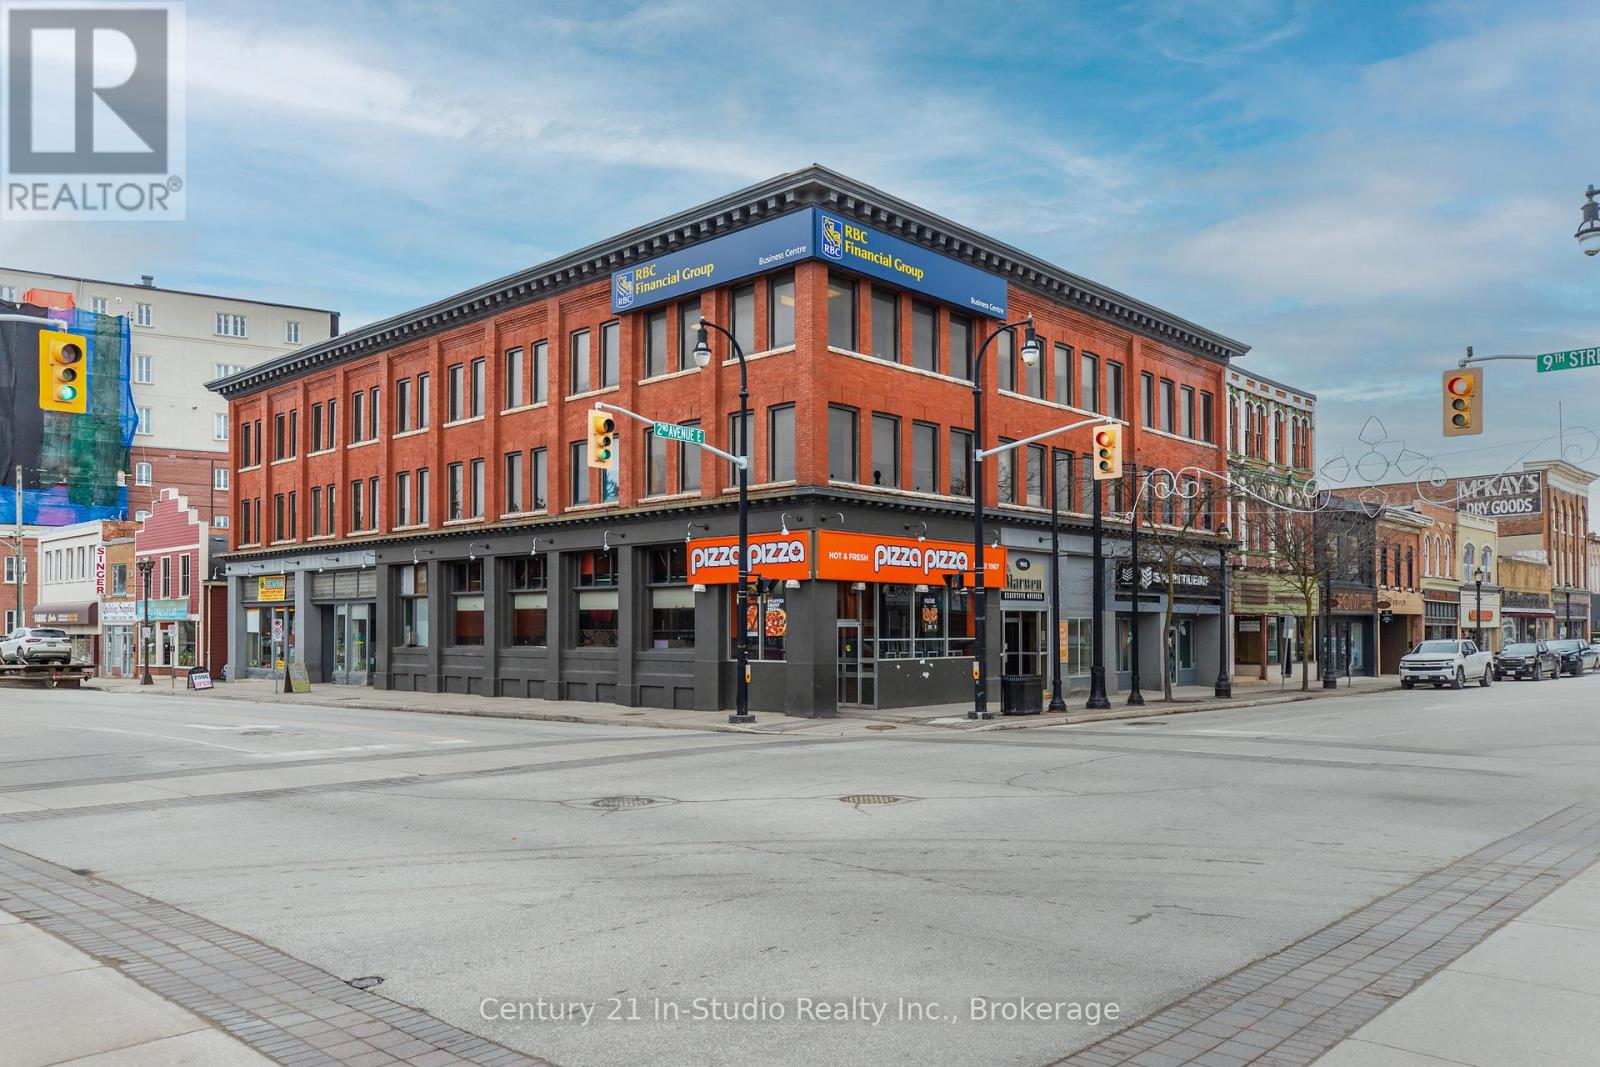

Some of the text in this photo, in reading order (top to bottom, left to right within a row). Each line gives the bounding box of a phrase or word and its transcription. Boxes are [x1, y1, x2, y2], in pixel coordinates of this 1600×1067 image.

[844, 223, 868, 245] RBC
[758, 244, 807, 266] Business Centre
[823, 243, 841, 258] RBC
[844, 240, 924, 283] Financial Group
[635, 264, 657, 281] RBC
[635, 262, 714, 295] Financial Group
[617, 294, 632, 307] RBC
[970, 296, 989, 311] Business
[1542, 352, 1566, 371] 9TH
[668, 425, 695, 441] AVENUE
[696, 430, 702, 443] E
[1465, 497, 1534, 516] DRY GOODS
[747, 540, 805, 573] pizza
[828, 551, 870, 562] HOT & FRESH
[873, 544, 969, 576] pizza pizza
[96, 546, 106, 595] SINGER
